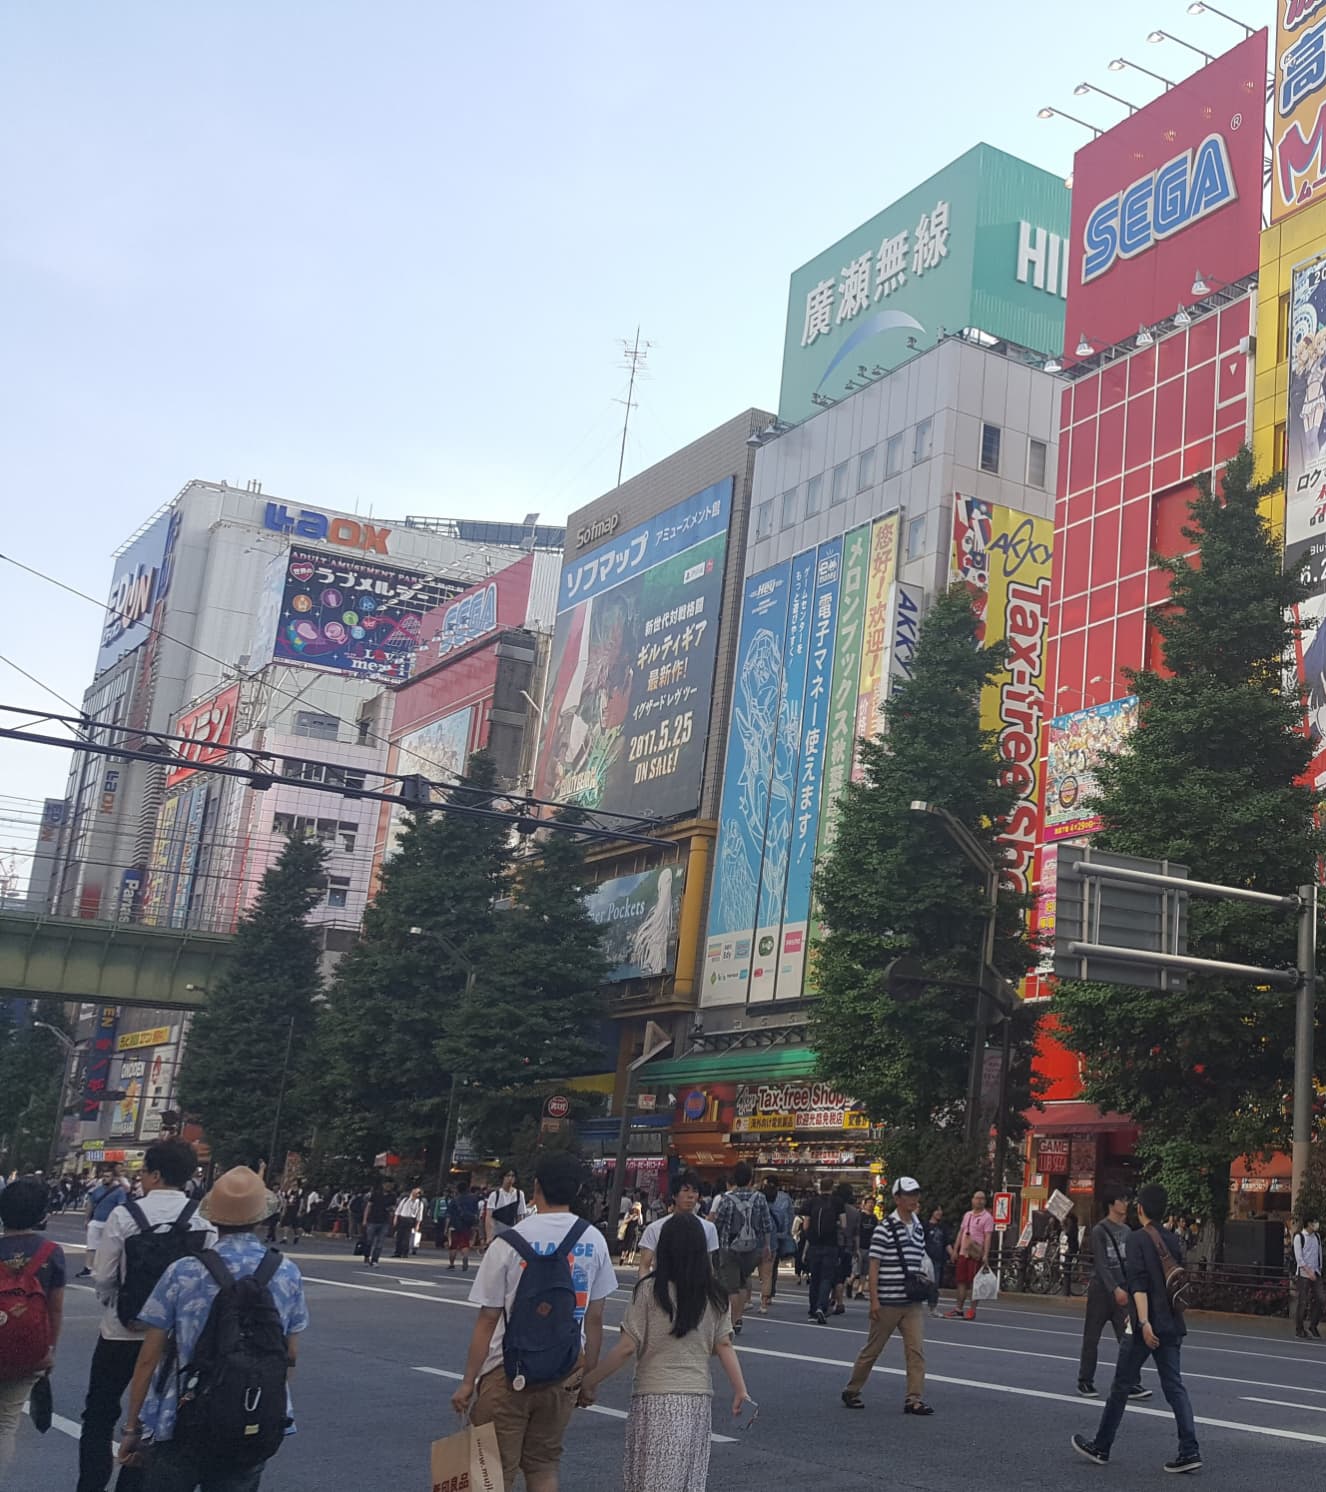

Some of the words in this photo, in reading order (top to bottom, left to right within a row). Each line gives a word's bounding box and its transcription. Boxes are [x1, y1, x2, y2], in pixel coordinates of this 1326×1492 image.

[1081, 132, 1239, 286] SEGA
[567, 530, 649, 599] ソフマップ
[655, 500, 721, 546] アミューズメント館
[575, 513, 620, 549] Sofmap
[637, 619, 708, 671] ギルティギア
[628, 710, 694, 763] 2017.5.25
[797, 592, 834, 866] 電子マネー使えます!
[633, 760, 649, 785] ON
[649, 746, 681, 781] SALE!
[607, 898, 647, 922] Pockets
